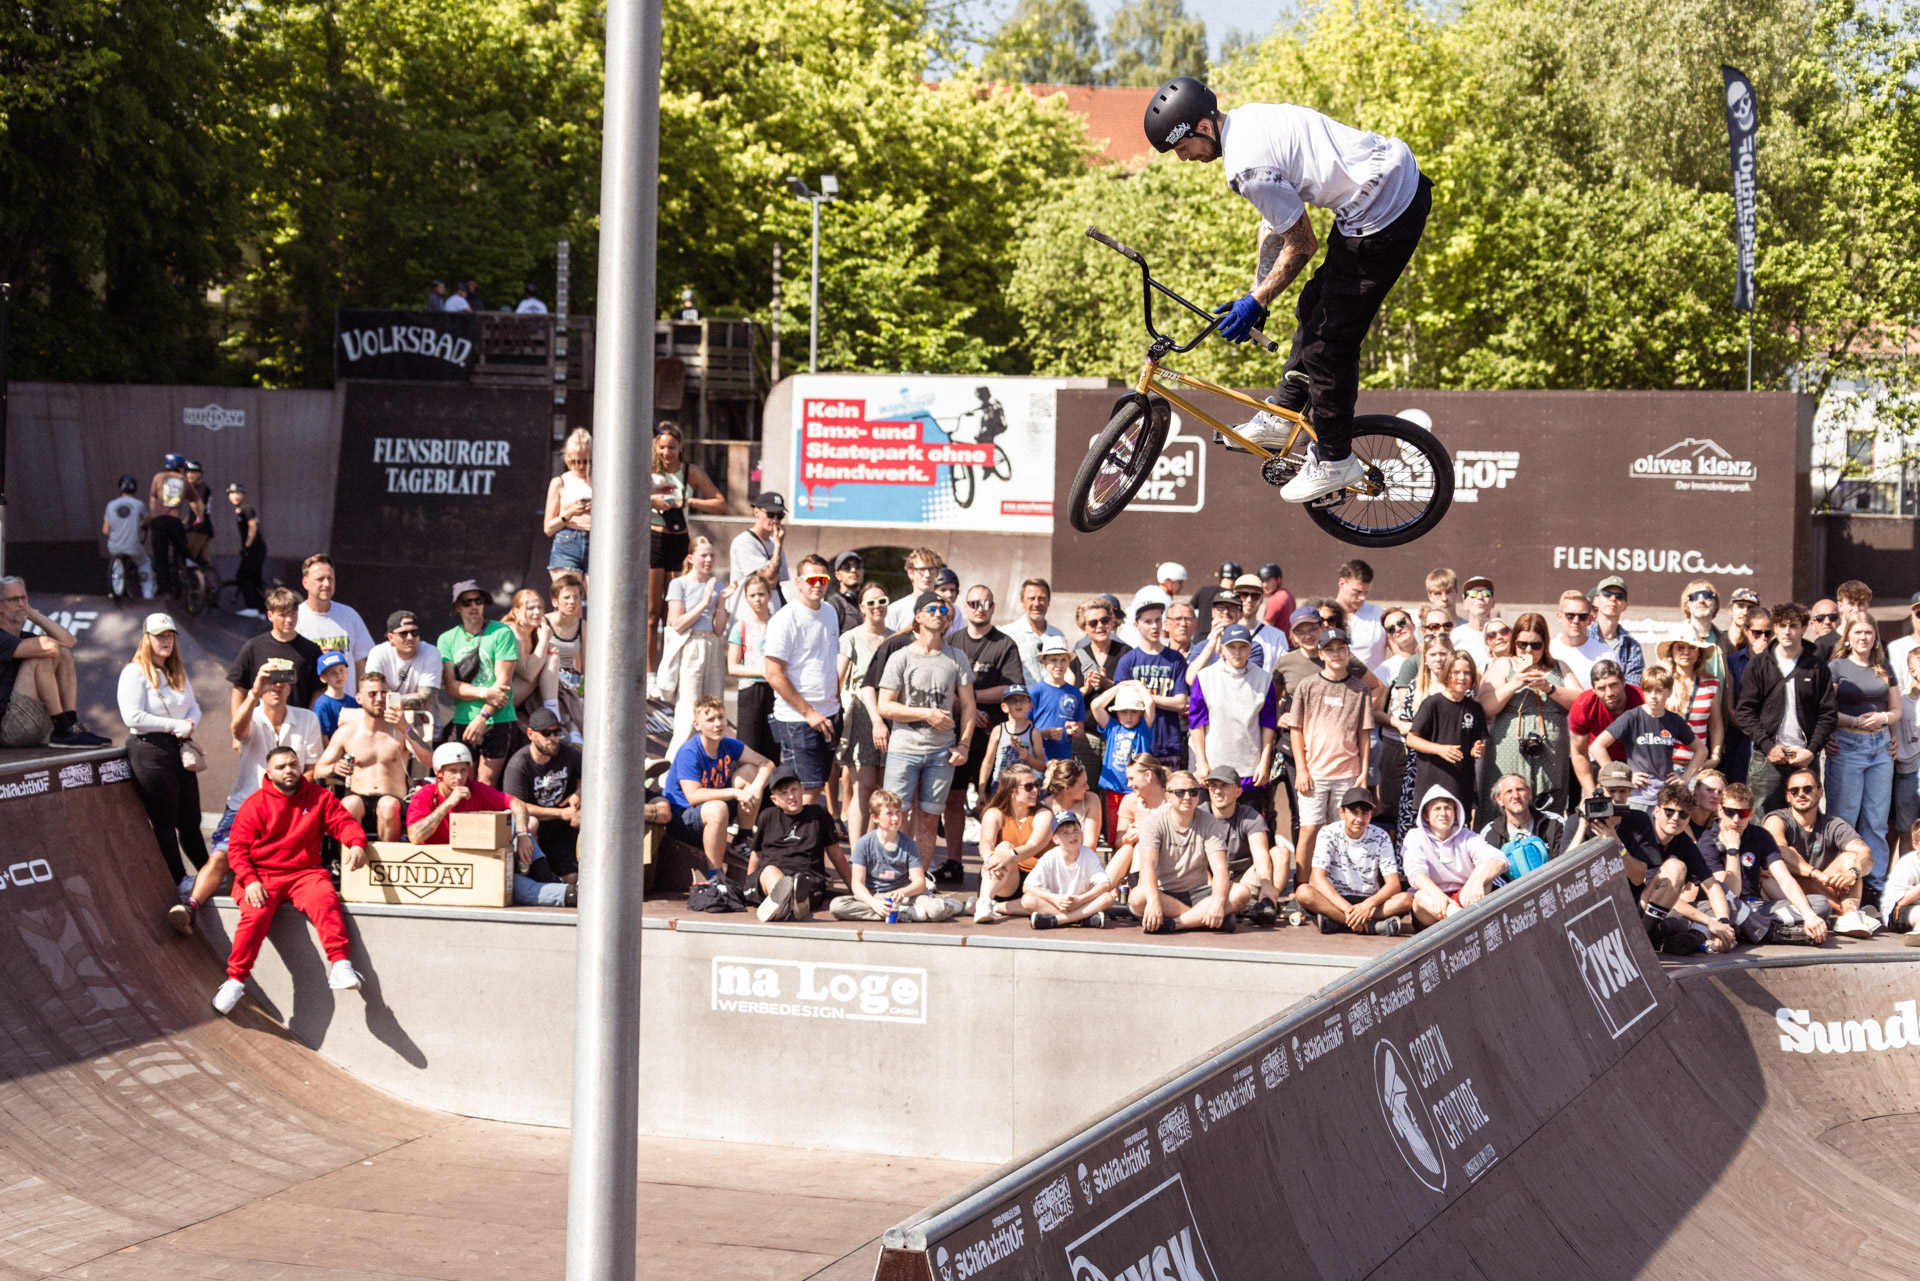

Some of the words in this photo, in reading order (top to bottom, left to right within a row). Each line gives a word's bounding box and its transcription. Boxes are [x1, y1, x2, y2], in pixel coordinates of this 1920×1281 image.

[807, 402, 860, 418] Kein
[807, 422, 868, 439] Bmx-
[872, 424, 917, 440] und
[373, 437, 511, 466] FLENSBURGER
[806, 442, 923, 462] Skatepark
[928, 444, 987, 463] ohne
[385, 467, 496, 495] TAGEBLATT
[805, 462, 930, 482] Handwerk.
[1554, 546, 1703, 573] FLENSBURG
[374, 864, 469, 885] SUNDAY
[1587, 928, 1640, 1000] JYSK
[718, 965, 781, 998] na
[719, 999, 846, 1019] WERBEDESIGN
[1775, 1000, 1920, 1054] Sund
[1433, 1078, 1490, 1150] CAPTURE
